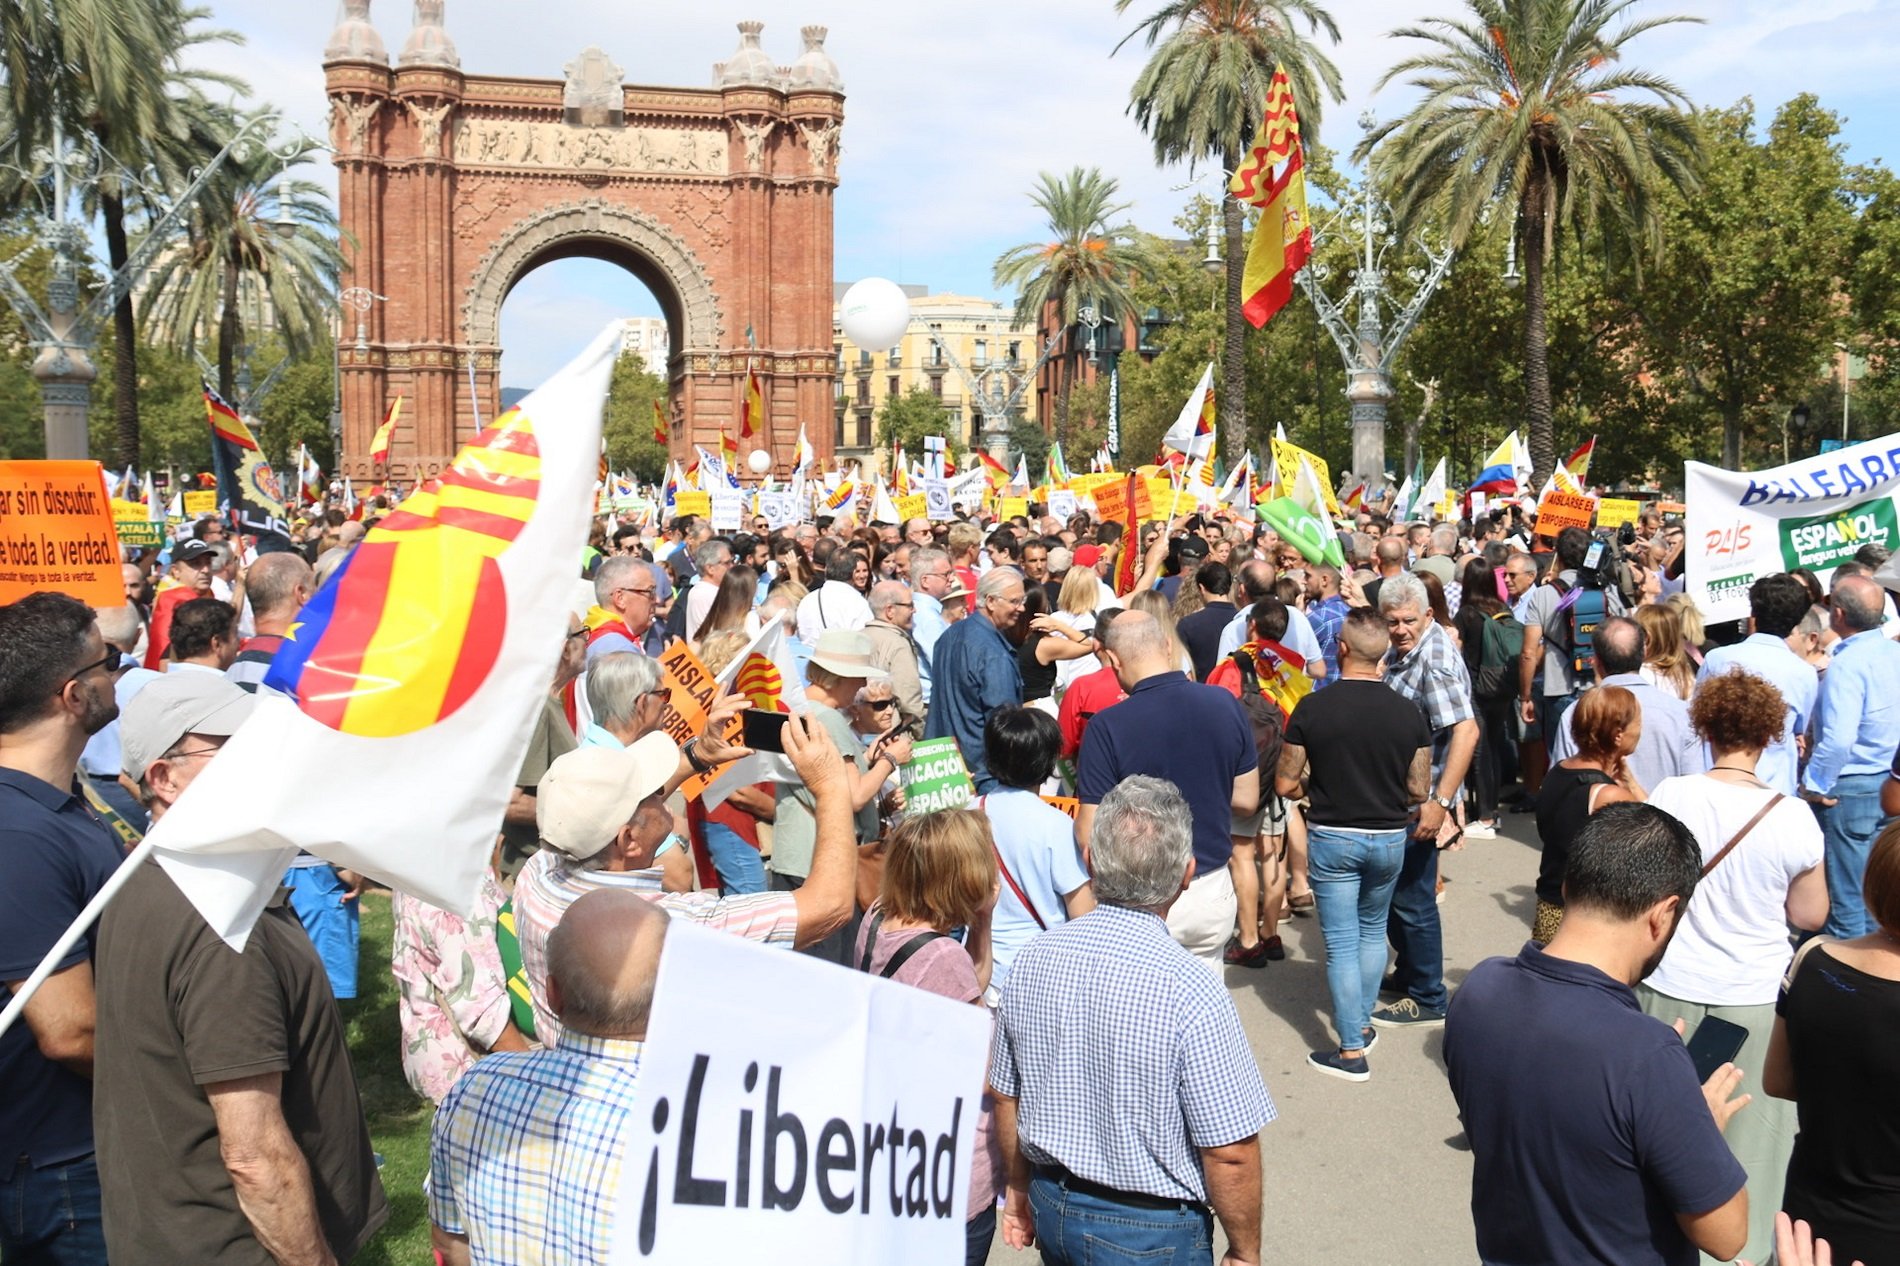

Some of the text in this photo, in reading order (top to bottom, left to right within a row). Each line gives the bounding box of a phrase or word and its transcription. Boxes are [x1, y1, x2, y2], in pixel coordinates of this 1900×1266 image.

[16, 482, 41, 515] sin
[1548, 494, 1595, 512] AISLARSE ES
[120, 533, 162, 546] ASTELLÀ
[7, 533, 38, 566] toda
[41, 533, 56, 566] la
[59, 532, 116, 565] verdad.
[1798, 549, 1837, 567] lengua
[1709, 590, 1722, 603] DE
[638, 1053, 964, 1257] ¡Libertad
